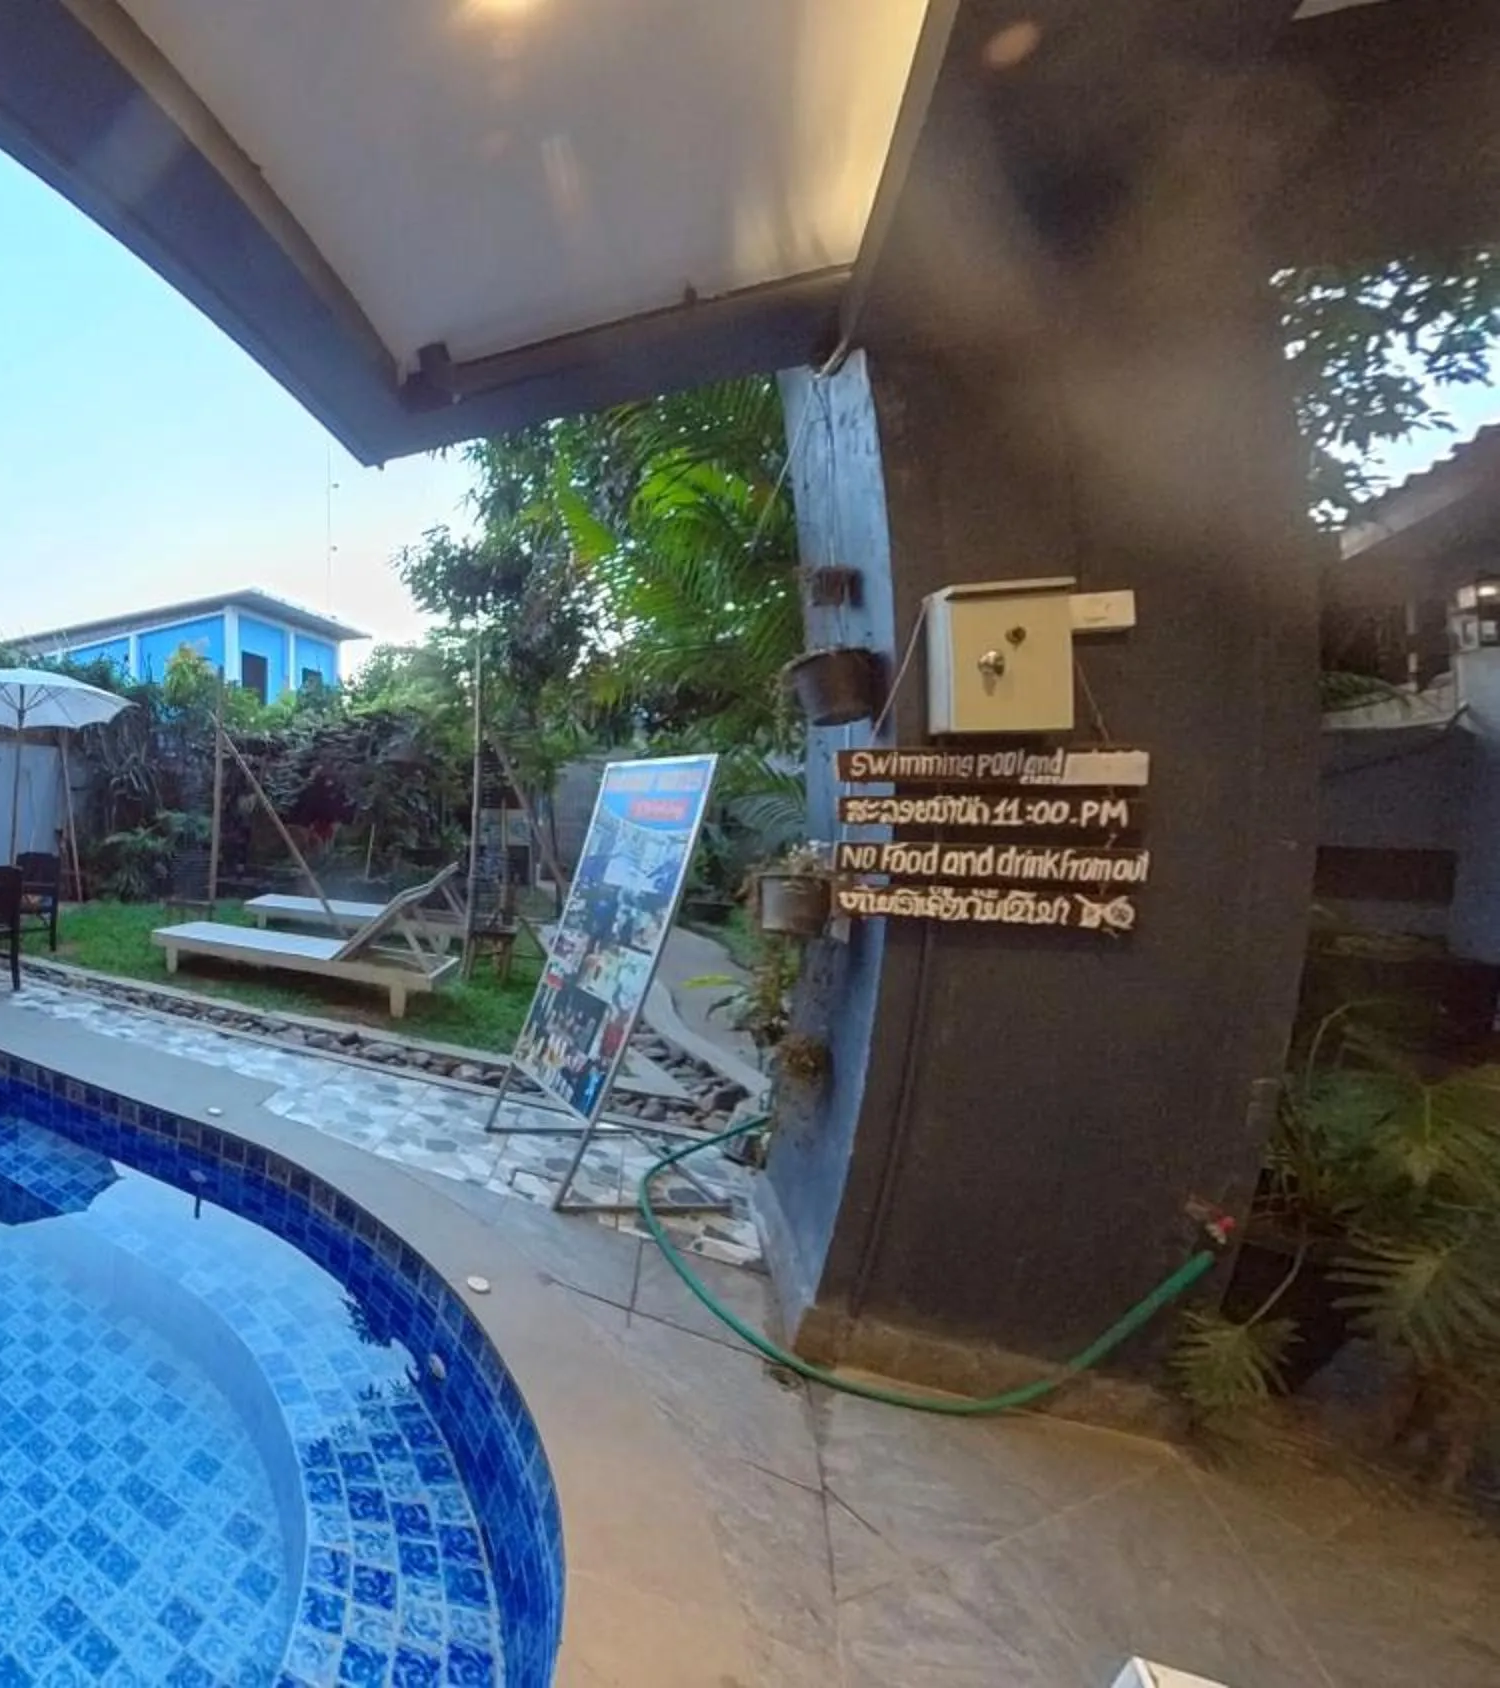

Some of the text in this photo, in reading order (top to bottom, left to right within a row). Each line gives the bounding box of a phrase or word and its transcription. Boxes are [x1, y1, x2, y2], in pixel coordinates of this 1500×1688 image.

[850, 751, 975, 778] Swimming
[881, 842, 941, 875] Food
[941, 844, 995, 877] and
[1112, 850, 1150, 882] out
